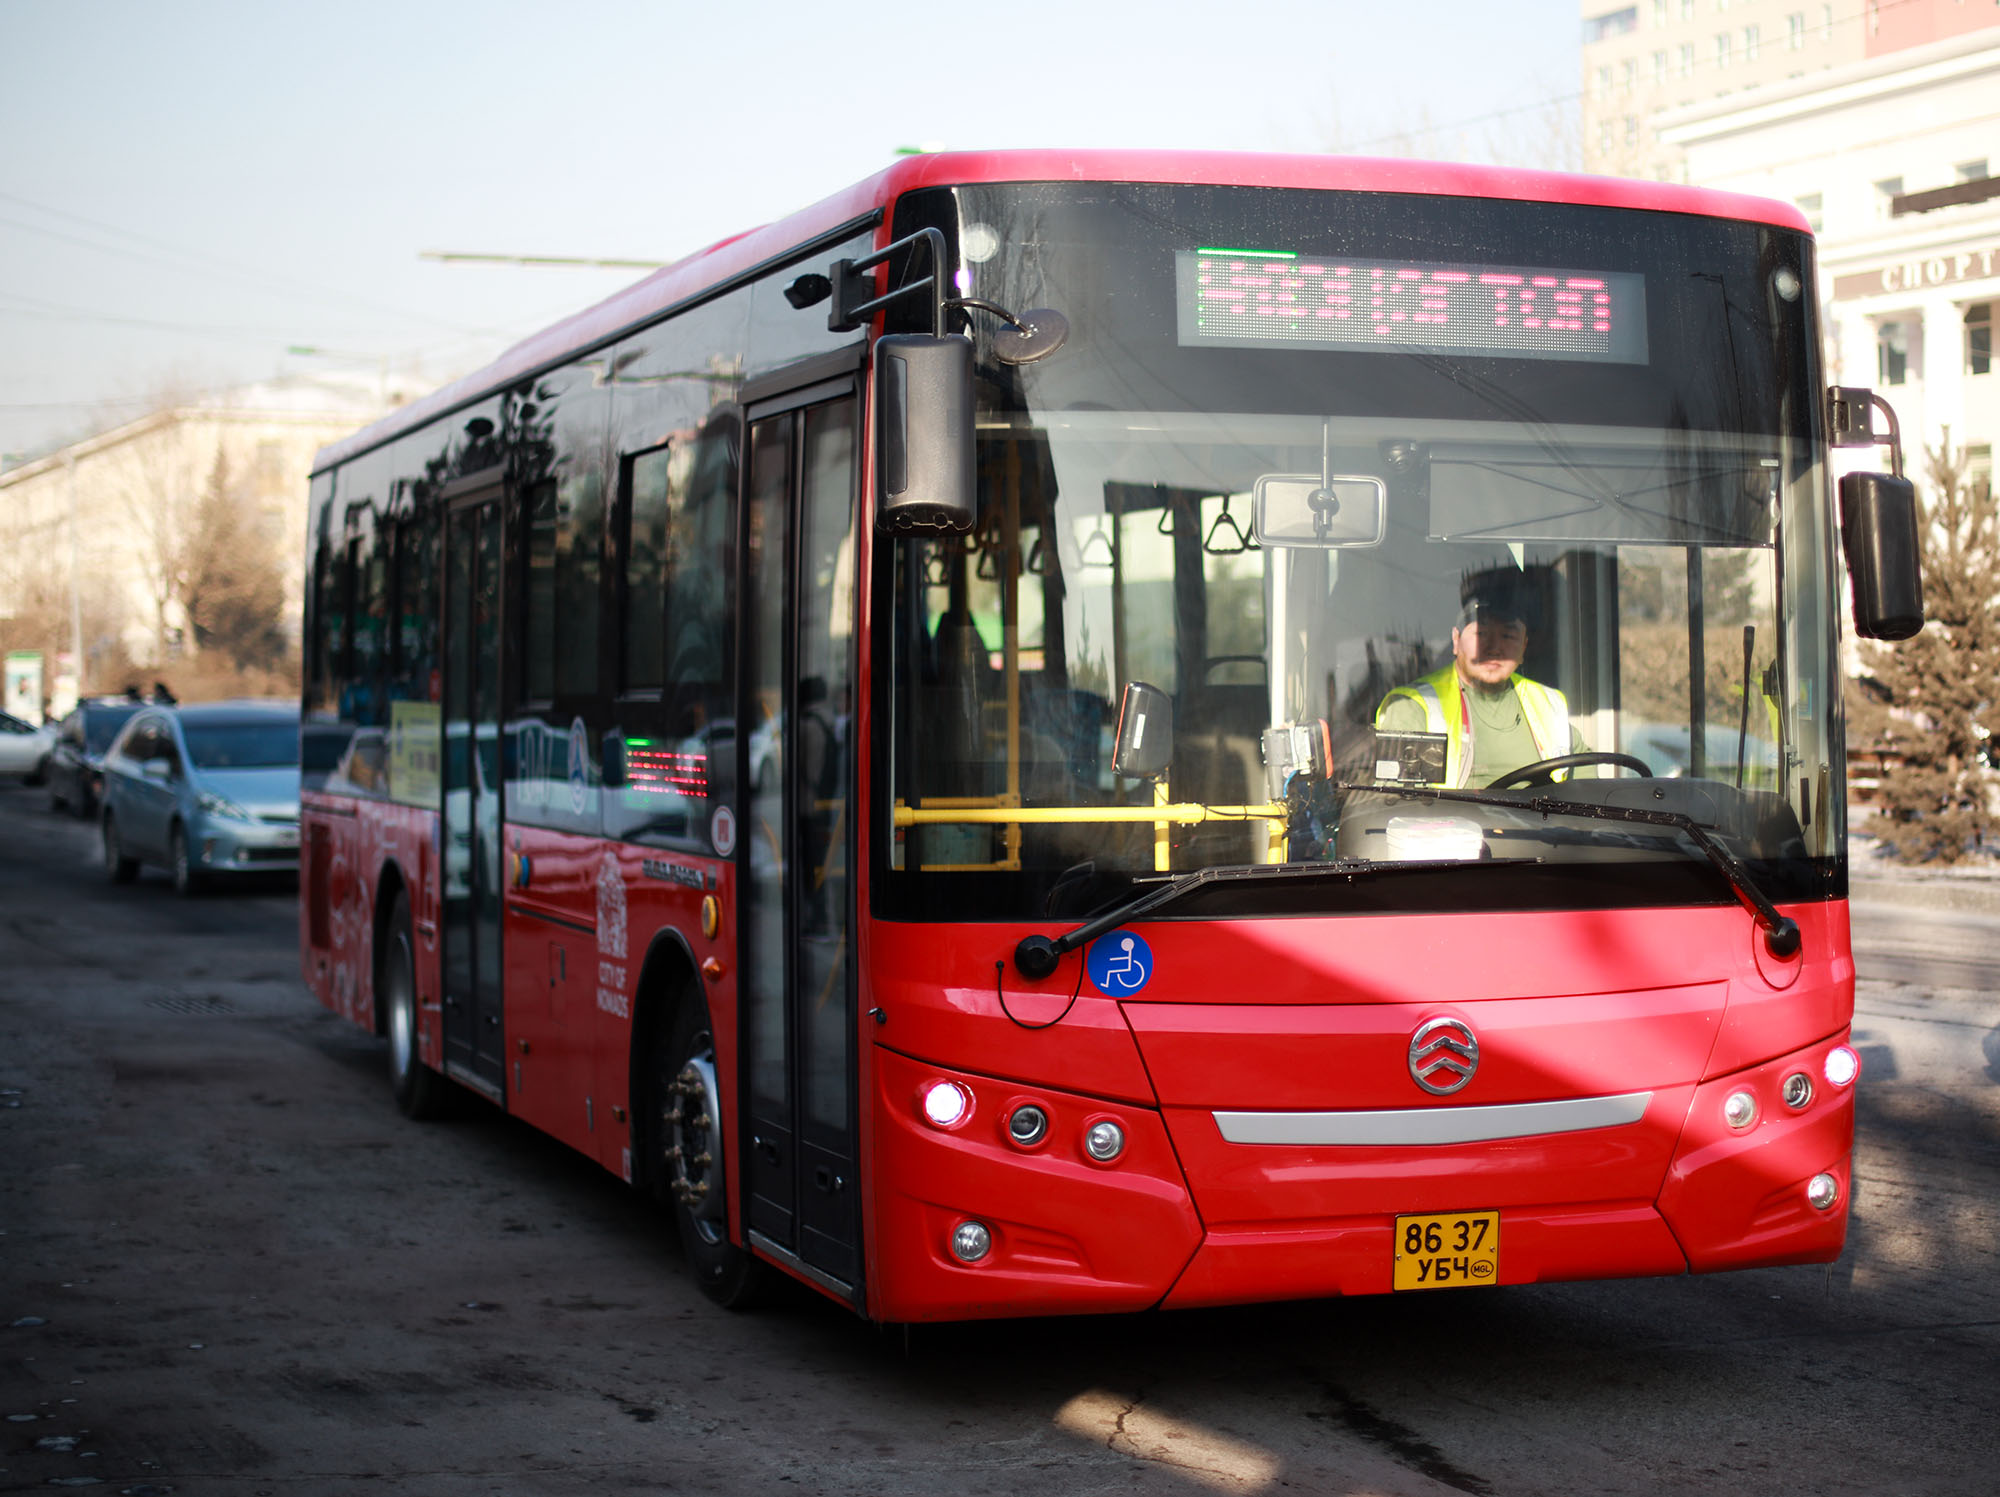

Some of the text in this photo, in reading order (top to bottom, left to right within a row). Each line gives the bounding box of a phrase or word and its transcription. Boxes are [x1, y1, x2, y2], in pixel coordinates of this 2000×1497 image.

[1881, 248, 1996, 293] СПОРТ
[1404, 1219, 1490, 1255] 86 37
[1417, 1256, 1469, 1282] УБЧ
[1473, 1264, 1491, 1274] MGL
